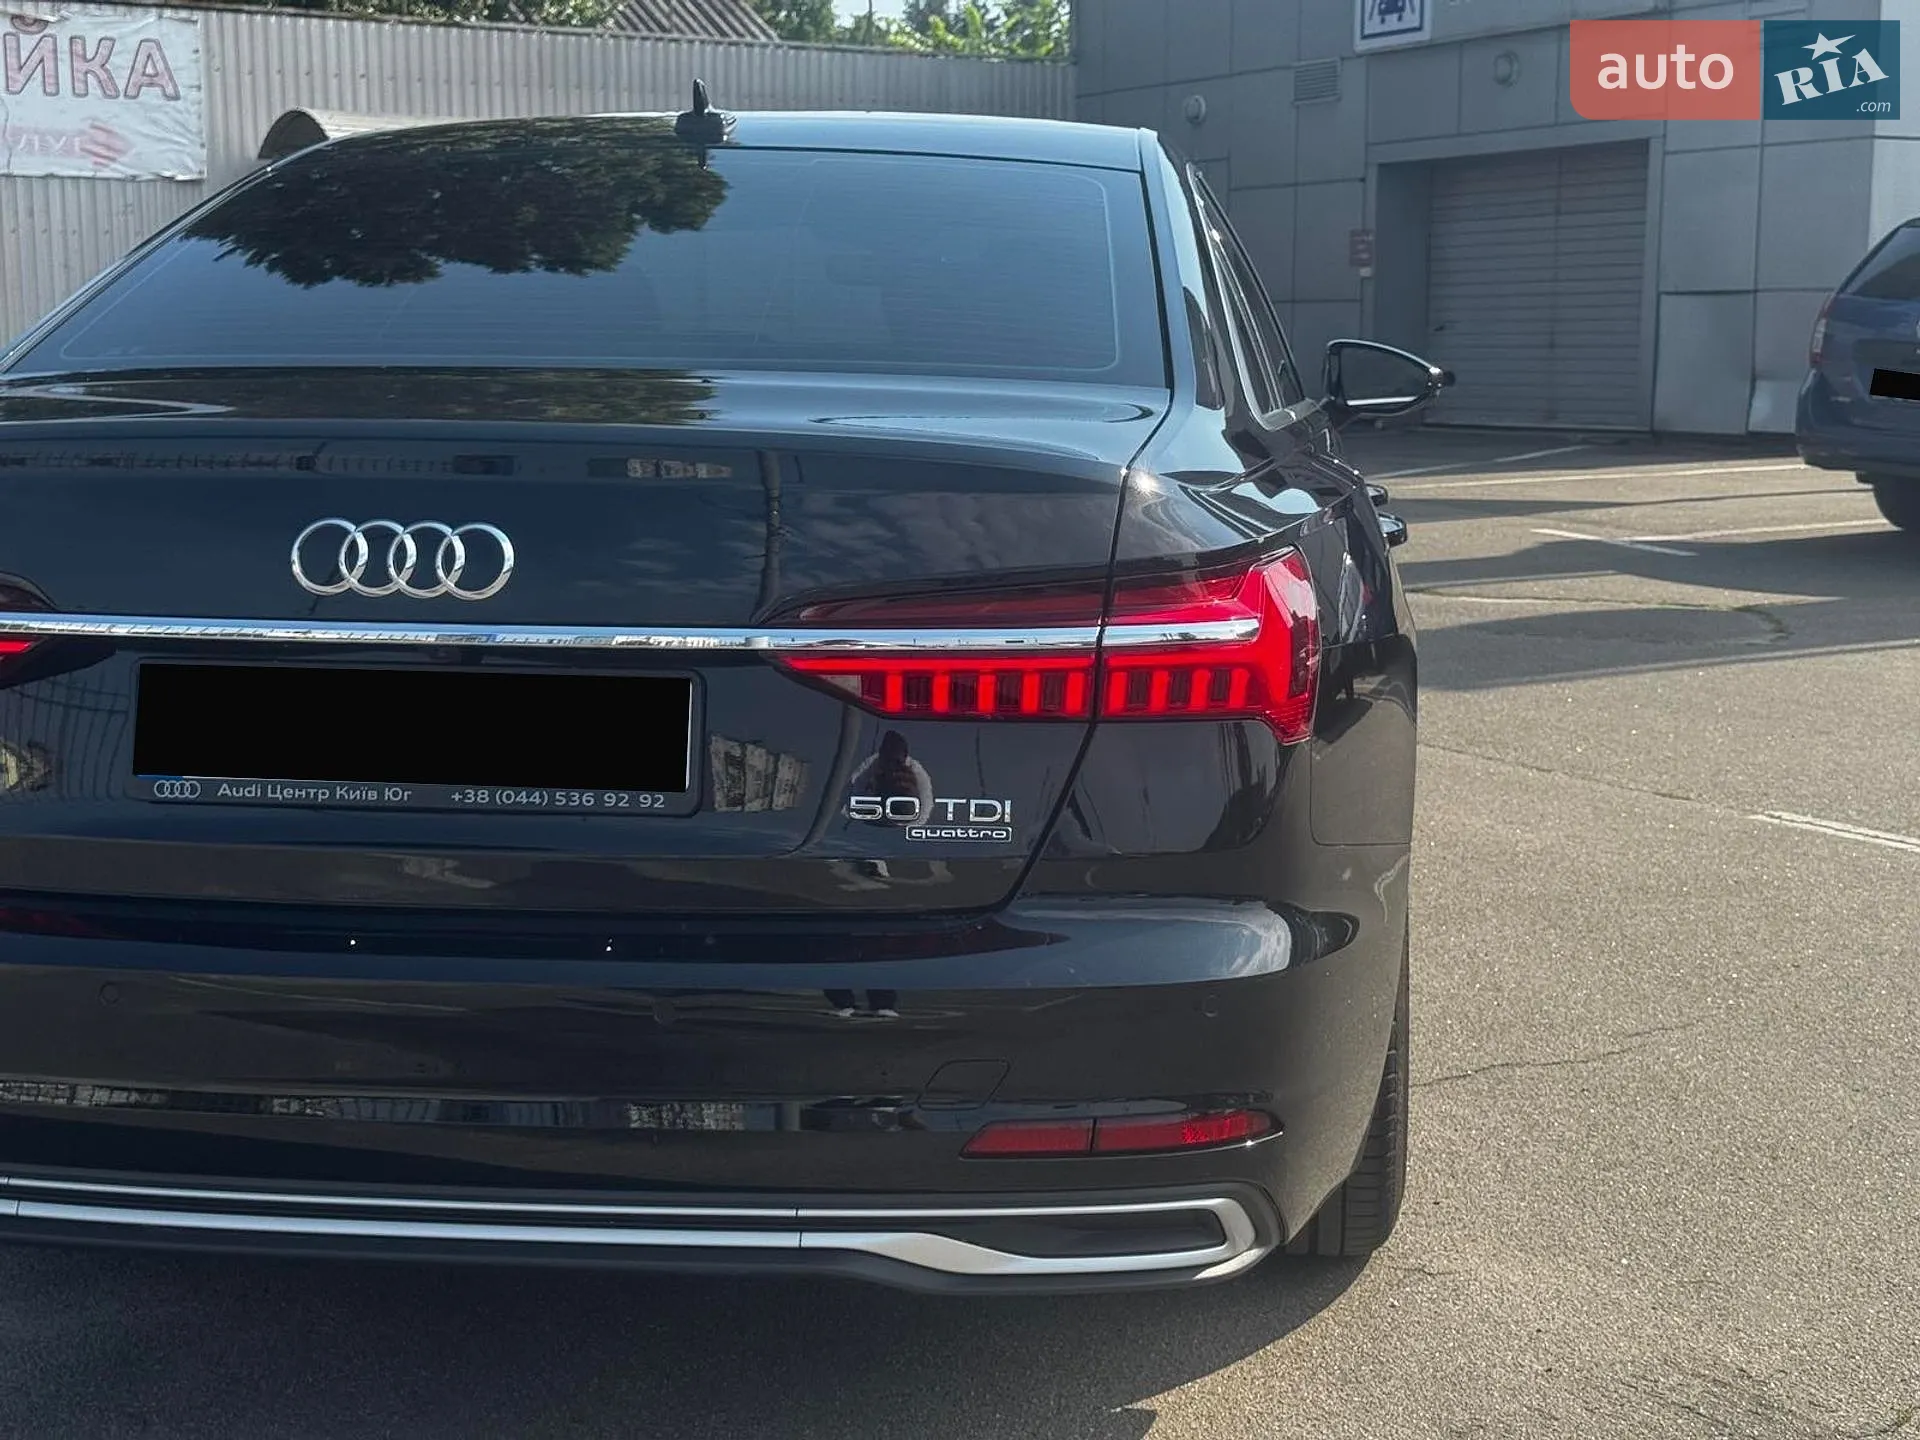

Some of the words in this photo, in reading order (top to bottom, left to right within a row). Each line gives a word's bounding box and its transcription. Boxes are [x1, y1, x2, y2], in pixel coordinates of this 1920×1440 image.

[217, 783, 261, 798] Audi
[267, 784, 329, 802] Центр
[336, 785, 378, 801] Київ
[384, 787, 412, 801] Юг
[451, 789, 489, 803] +38
[495, 789, 548, 805] (044)
[555, 791, 594, 806] 536
[603, 793, 629, 807] 92
[639, 794, 665, 808] 92
[850, 796, 920, 820] 50
[935, 799, 1011, 822] TDI
[911, 828, 1007, 839] quattro
